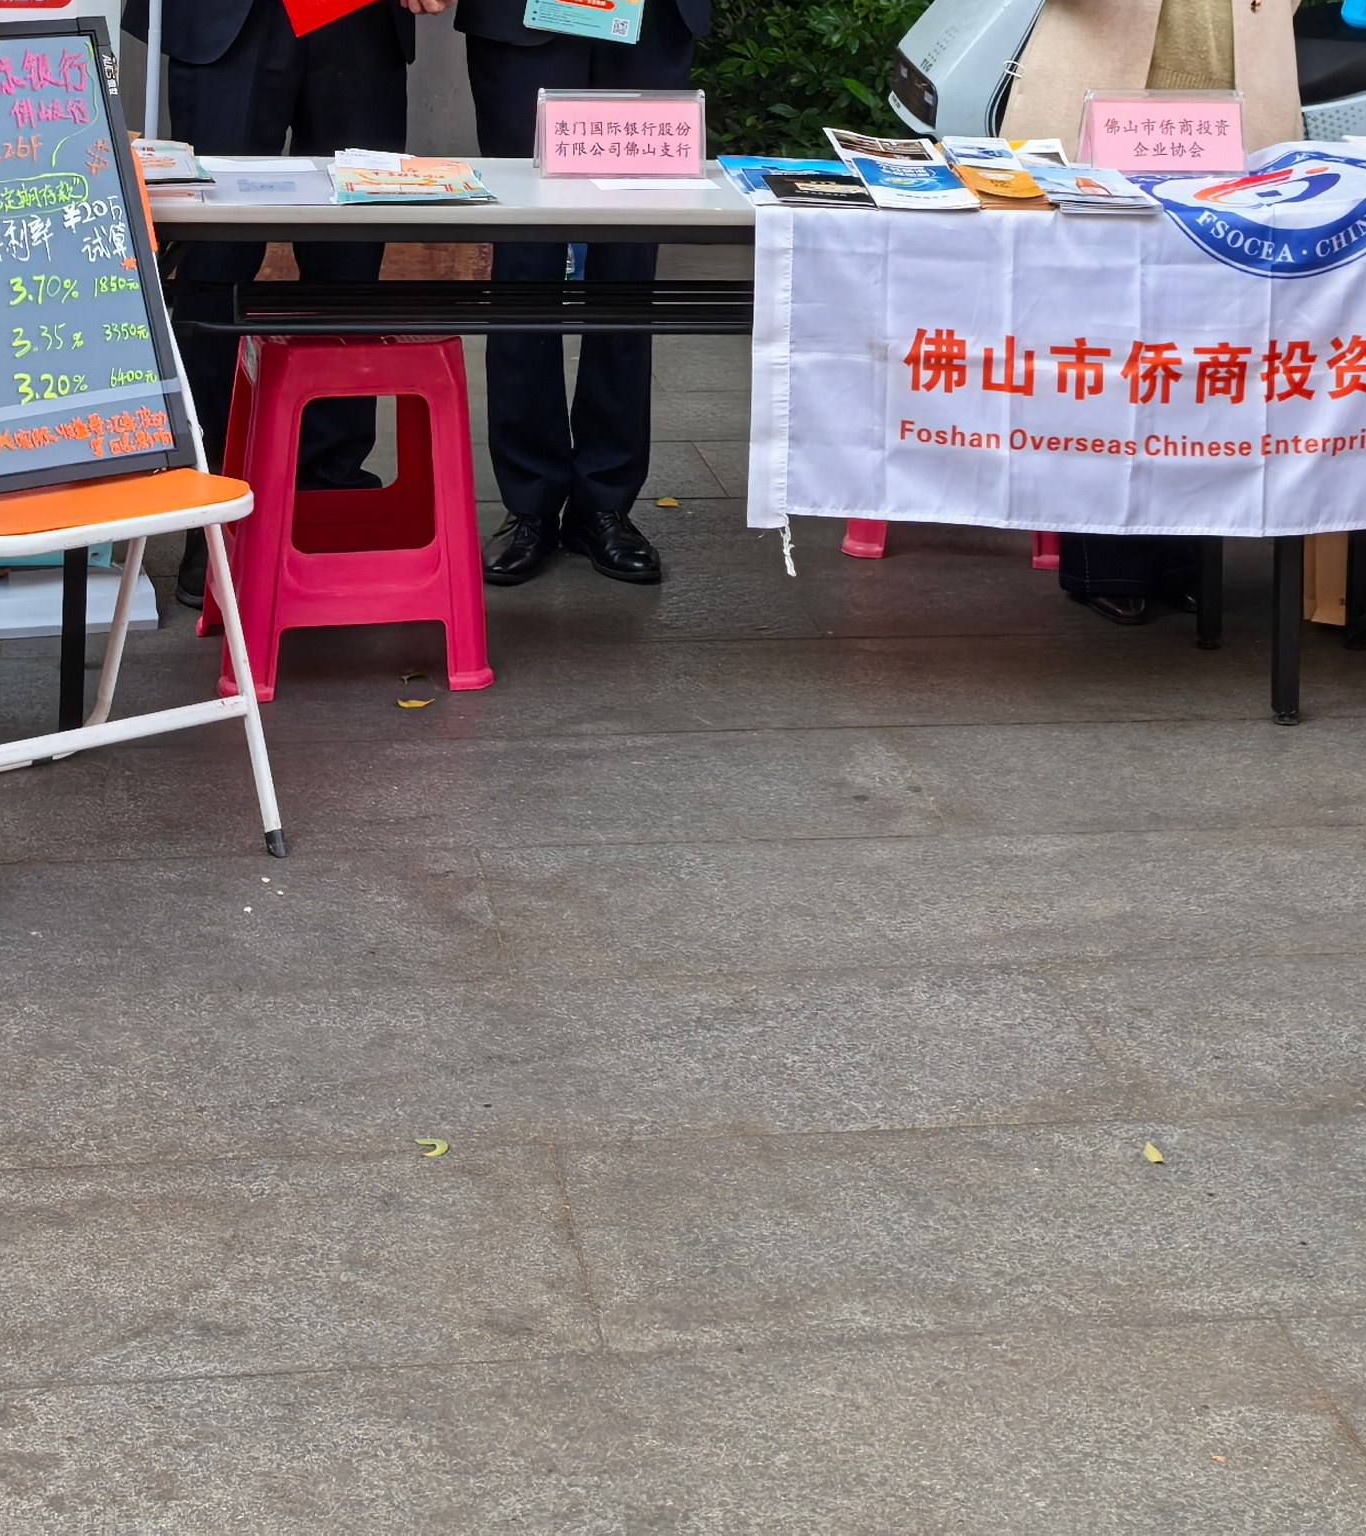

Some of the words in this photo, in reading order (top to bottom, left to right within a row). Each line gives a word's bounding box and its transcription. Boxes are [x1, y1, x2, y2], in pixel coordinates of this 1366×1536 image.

[554, 120, 691, 137] 澳门国际银行股份
[1104, 118, 1230, 137] 佛山市侨商投资
[554, 141, 692, 158] 有限公司佛山支行
[1133, 141, 1205, 158] 企业协会
[1195, 211, 1294, 263] FSOCEA
[9, 274, 79, 305] 3.70%
[93, 275, 140, 298] 1850元
[12, 323, 84, 359] 3.35%
[102, 323, 150, 342] 3350元
[13, 373, 88, 406] 3.20%
[110, 368, 157, 388] 6400元
[900, 419, 1001, 449] Foshan
[1009, 428, 1137, 456] Overseas
[1144, 434, 1252, 457] Chinese
